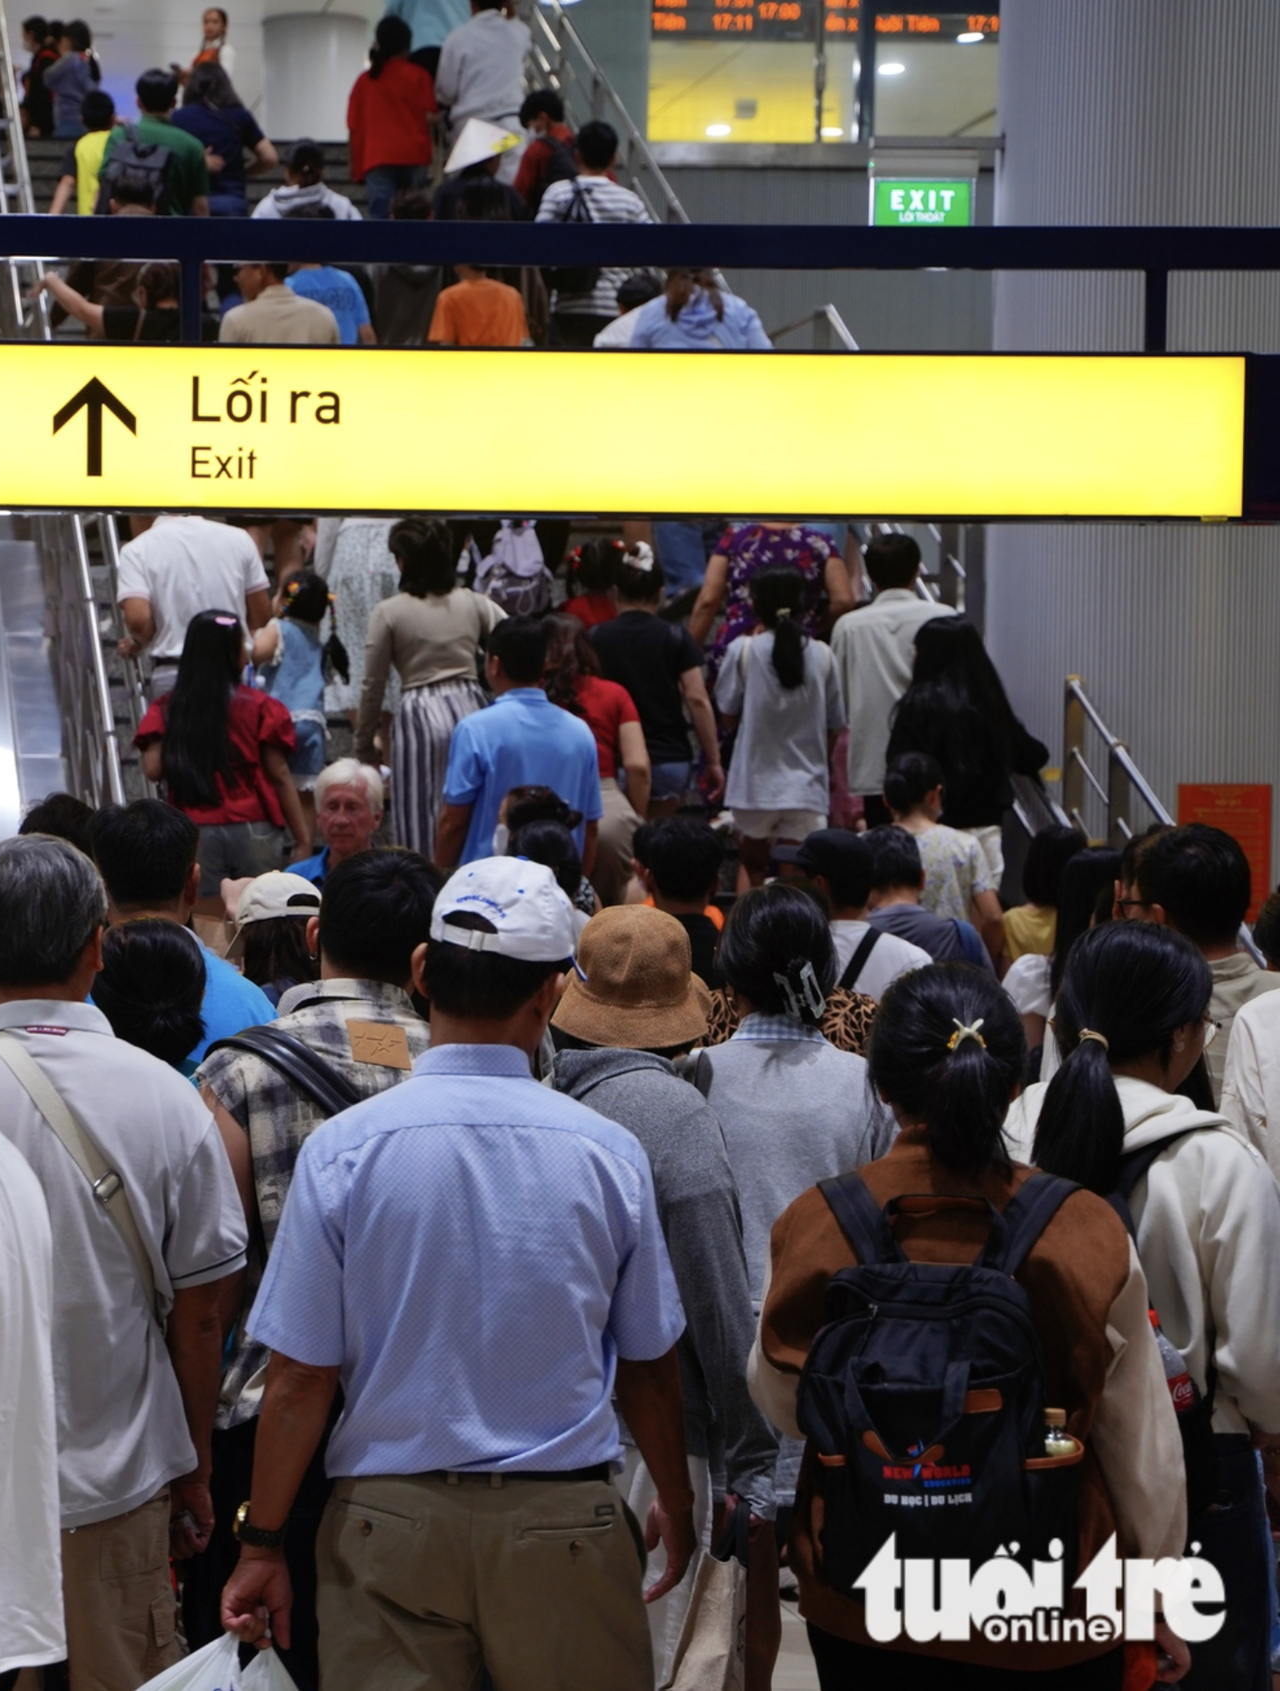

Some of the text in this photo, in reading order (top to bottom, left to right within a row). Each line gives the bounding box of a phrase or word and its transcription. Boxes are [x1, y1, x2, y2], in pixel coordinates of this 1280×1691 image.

[712, 13, 753, 31] 17:11
[967, 15, 1000, 32] 17:1
[890, 189, 955, 211] EXIT
[191, 370, 341, 424] Lối ra
[191, 446, 258, 479] Exit
[883, 1464, 971, 1480] NEW WORLD
[883, 1493, 899, 1505] DU
[930, 1495, 945, 1506] DU
